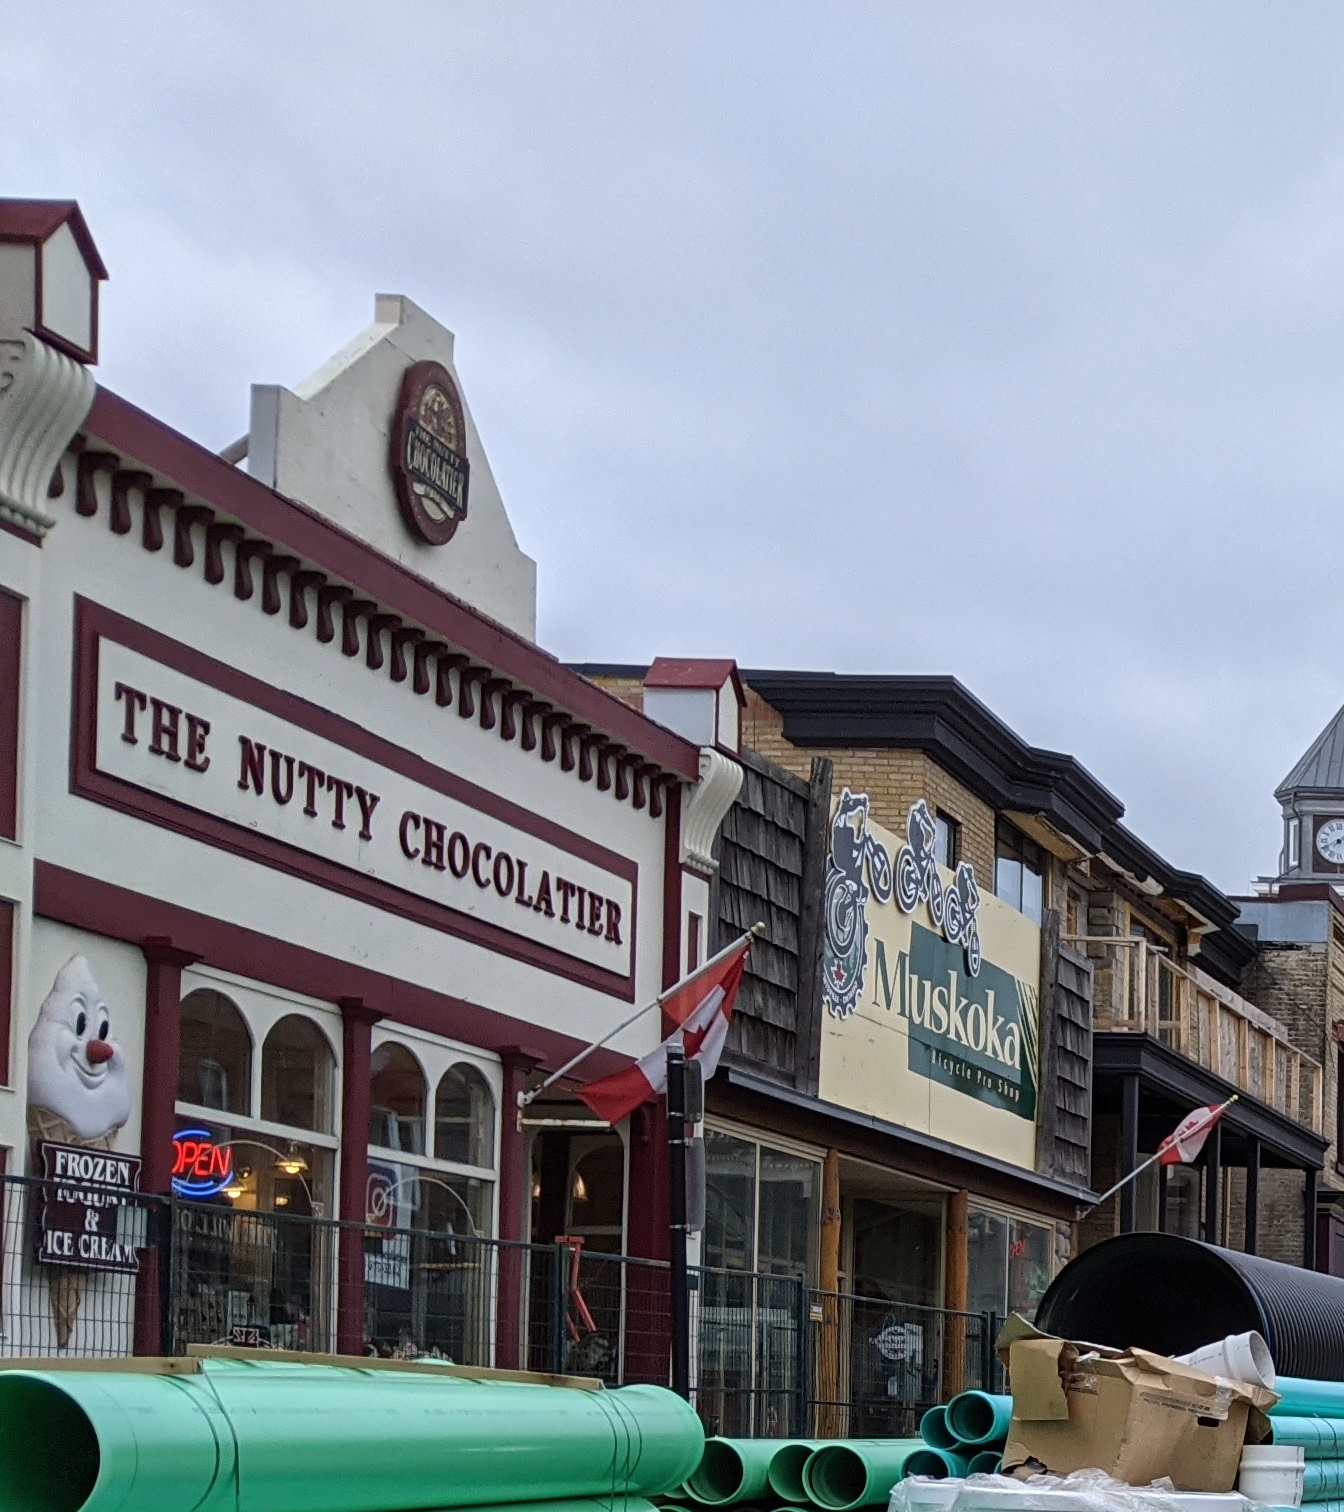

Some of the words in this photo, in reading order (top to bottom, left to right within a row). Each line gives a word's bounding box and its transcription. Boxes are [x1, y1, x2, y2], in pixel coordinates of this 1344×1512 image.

[406, 430, 465, 509] CHOCOLATIER
[114, 681, 211, 773] THE
[237, 735, 380, 841] NUTTY
[399, 810, 623, 945] CHOCOLATIER
[872, 937, 1021, 1070] Muskoka
[931, 1050, 972, 1080] Bicycle
[977, 1069, 992, 1089] Pro
[998, 1079, 1020, 1103] Shop
[55, 1150, 131, 1186] FROZEN
[46, 1229, 73, 1256] ICE
[79, 1234, 137, 1264] CREAM
[84, 1208, 99, 1232] &
